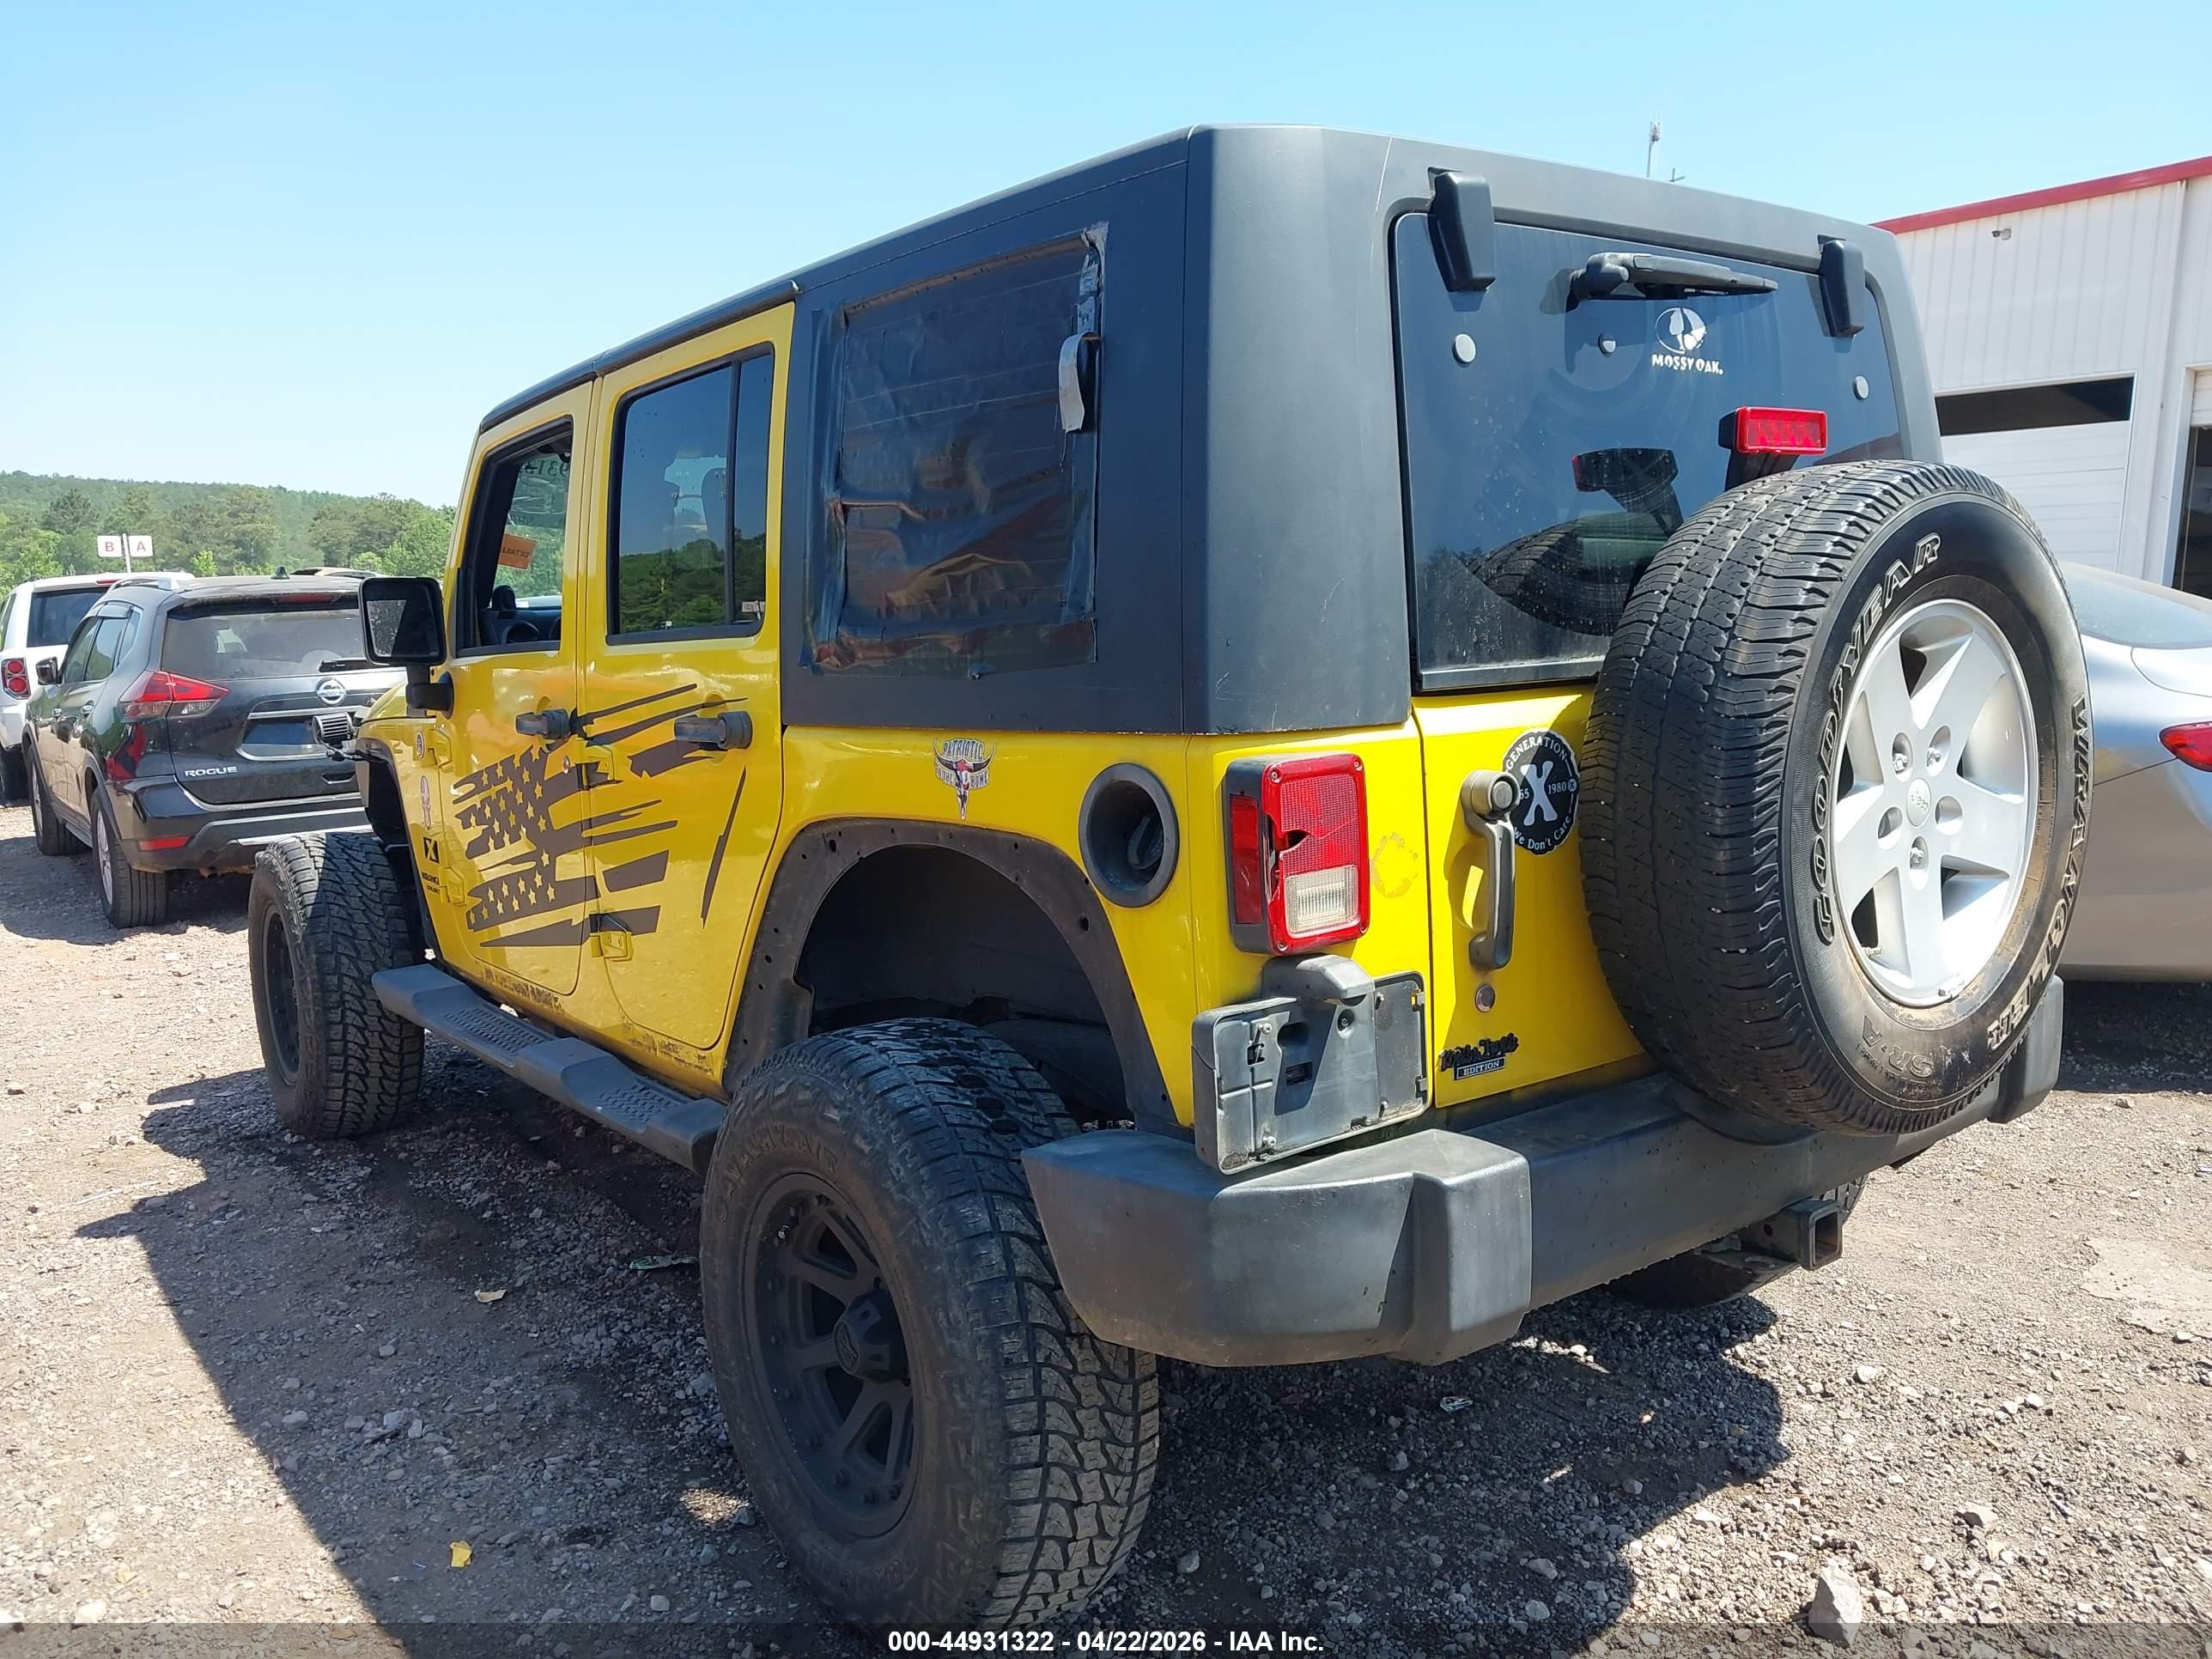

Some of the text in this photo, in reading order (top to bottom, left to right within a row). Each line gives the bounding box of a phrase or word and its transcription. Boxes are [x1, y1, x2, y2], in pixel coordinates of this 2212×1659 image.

[1651, 353, 1694, 371] MOSSY
[105, 541, 114, 552] B
[137, 541, 146, 552] A
[1810, 532, 1942, 945] GOODYEAR
[944, 738, 985, 763] PATRIOTIC
[1505, 736, 1568, 770] GENERATION
[185, 765, 238, 777] ROGUE
[1521, 761, 1558, 825] X
[1547, 781, 1567, 795] 1980
[1528, 837, 1552, 851] Don't
[1553, 815, 1571, 841] Care
[1986, 694, 2090, 1050] WRANGLER
[1462, 1060, 1500, 1077] EDITION
